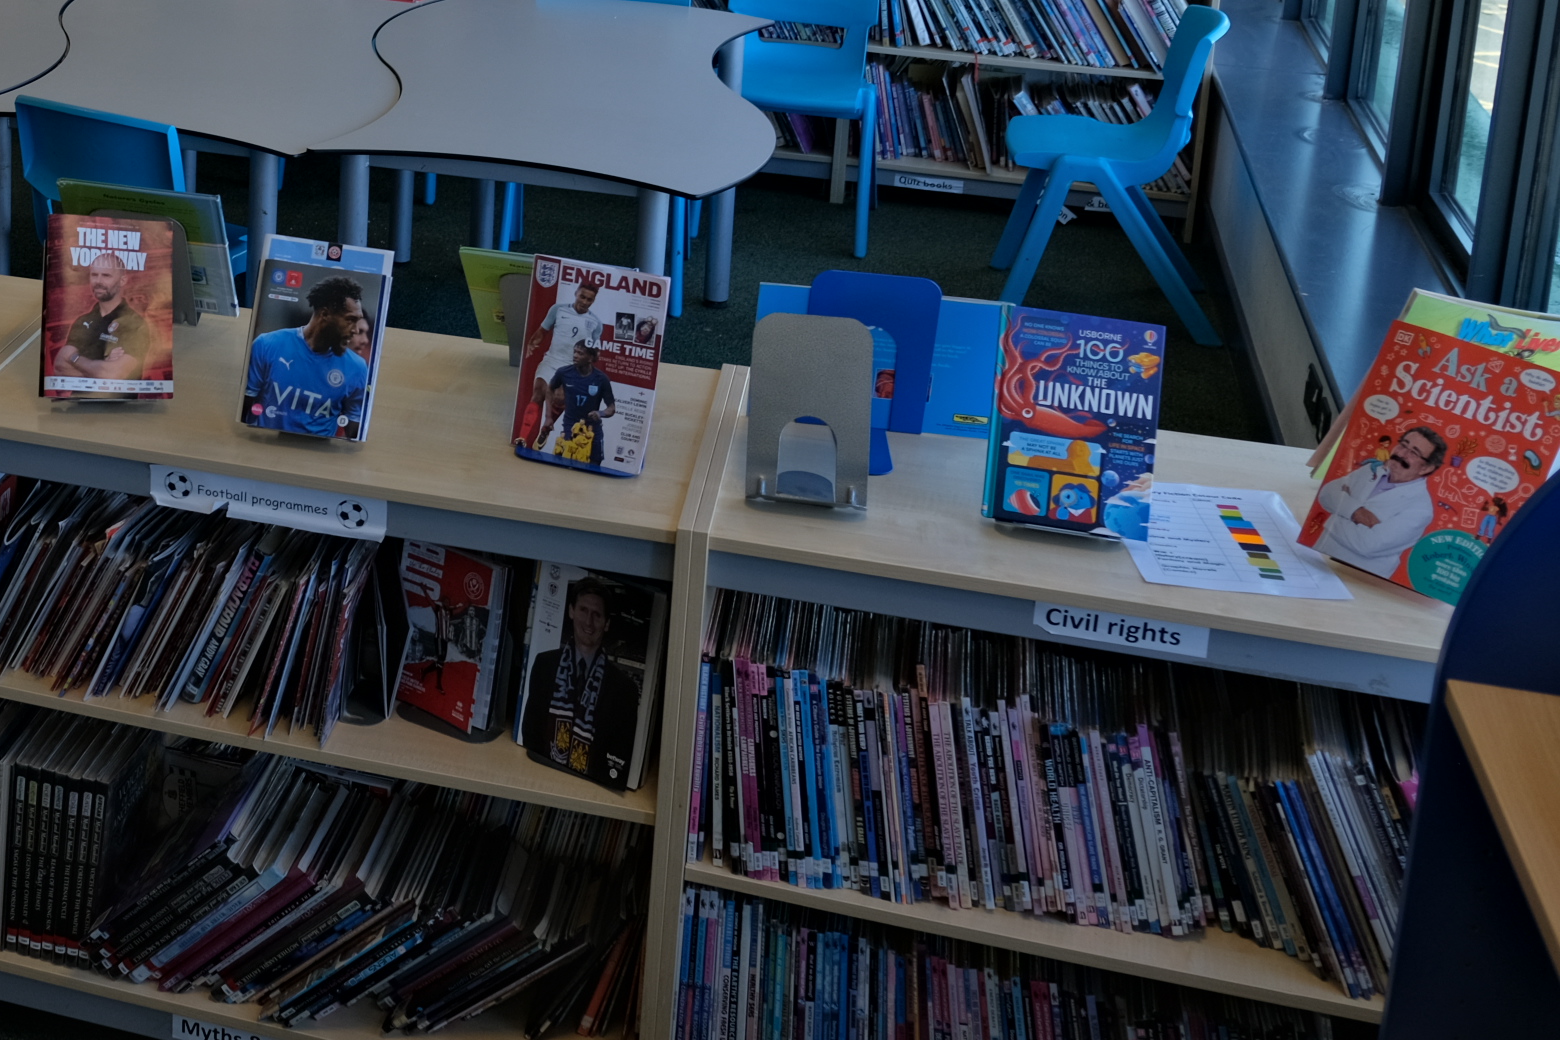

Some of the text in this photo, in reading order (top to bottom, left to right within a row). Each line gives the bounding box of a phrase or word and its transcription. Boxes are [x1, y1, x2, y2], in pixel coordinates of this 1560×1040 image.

[923, 180, 953, 190] books
[103, 193, 166, 206] Nature's Cycles
[77, 227, 141, 251] THE NEW
[561, 265, 662, 299] ENGLAND
[571, 326, 579, 338] 9
[1079, 329, 1122, 342] USBORNE
[584, 338, 621, 354] GAME
[623, 345, 655, 361] TIME
[1076, 340, 1124, 363] 100
[1066, 366, 1130, 381] KNOW ABOUT
[1074, 359, 1123, 372] THINGS TO
[1432, 348, 1517, 397] Ask a
[1087, 376, 1108, 388] THE
[273, 381, 333, 419] VITA
[575, 394, 588, 407] 17
[1038, 380, 1153, 421] UNKNOWN
[1390, 361, 1543, 442] Scientist
[197, 484, 328, 515] Football programmes
[1046, 608, 1181, 646] Civil rights
[944, 732, 952, 748] THE
[945, 749, 956, 789] ABOLITION
[965, 719, 981, 810] TALK ABOUT Youth Crime
[950, 790, 957, 798] OF
[1045, 759, 1061, 824] WORLD HEALTH
[952, 818, 961, 841] SLAVE
[955, 843, 964, 865] TRADE
[721, 975, 729, 1015] CONSERVING
[730, 972, 738, 1002] EARTH'S
